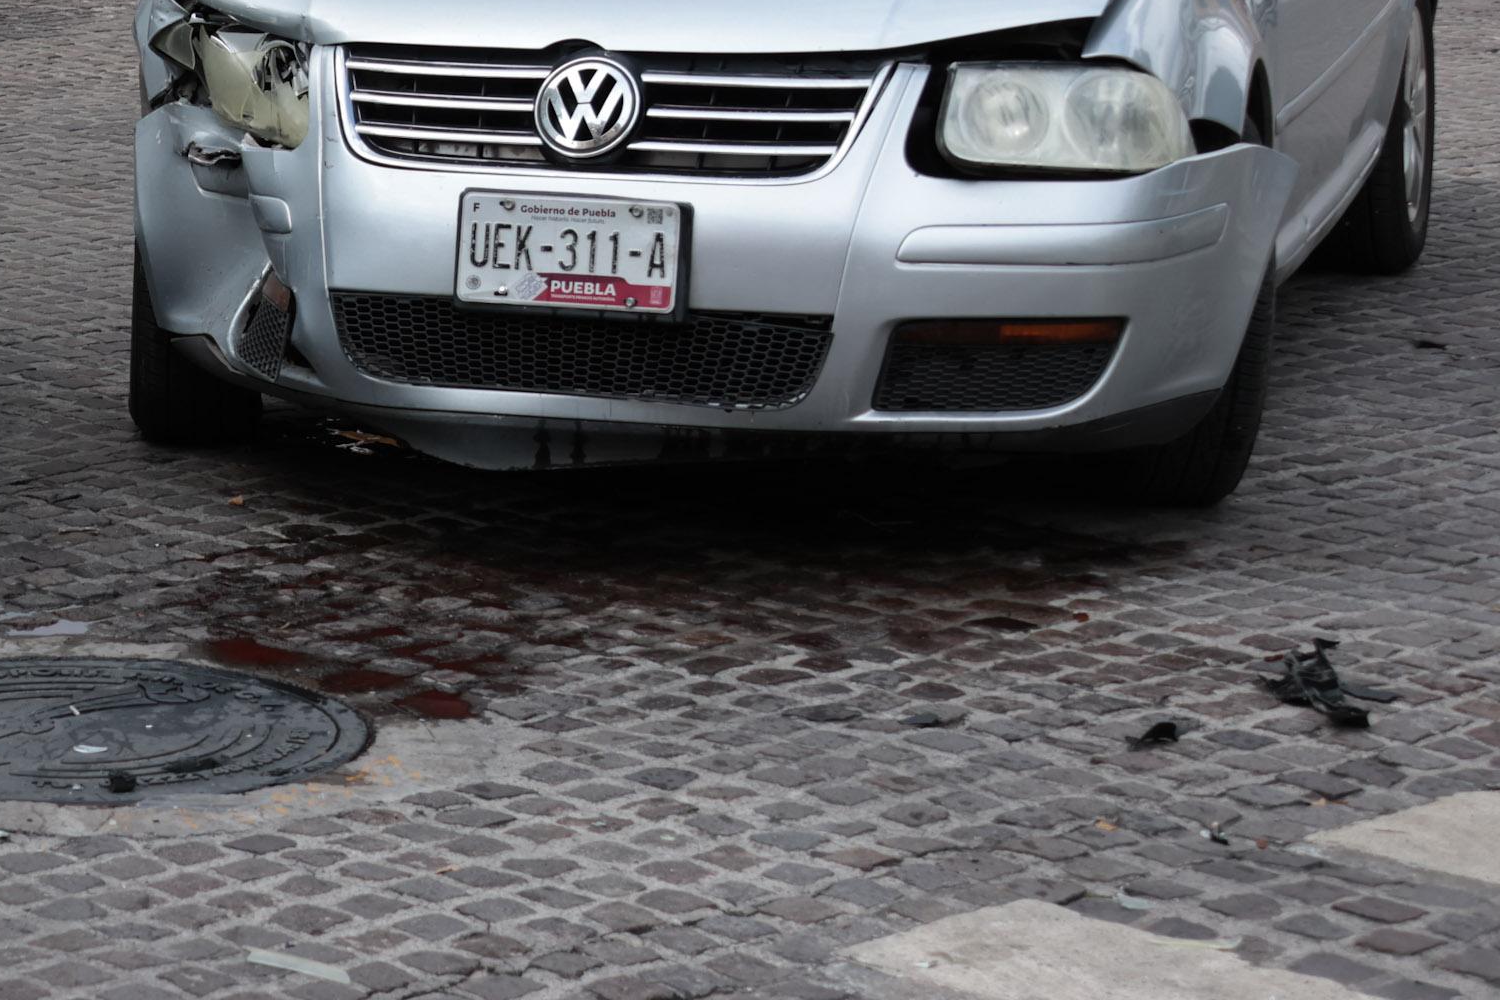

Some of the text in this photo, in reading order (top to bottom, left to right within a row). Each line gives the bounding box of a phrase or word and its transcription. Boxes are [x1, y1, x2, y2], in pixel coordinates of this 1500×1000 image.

[473, 202, 480, 213] F
[520, 204, 616, 218] Gobierno de Puebla
[470, 222, 665, 279] UEK-311-A
[550, 279, 617, 297] PUEBLA
